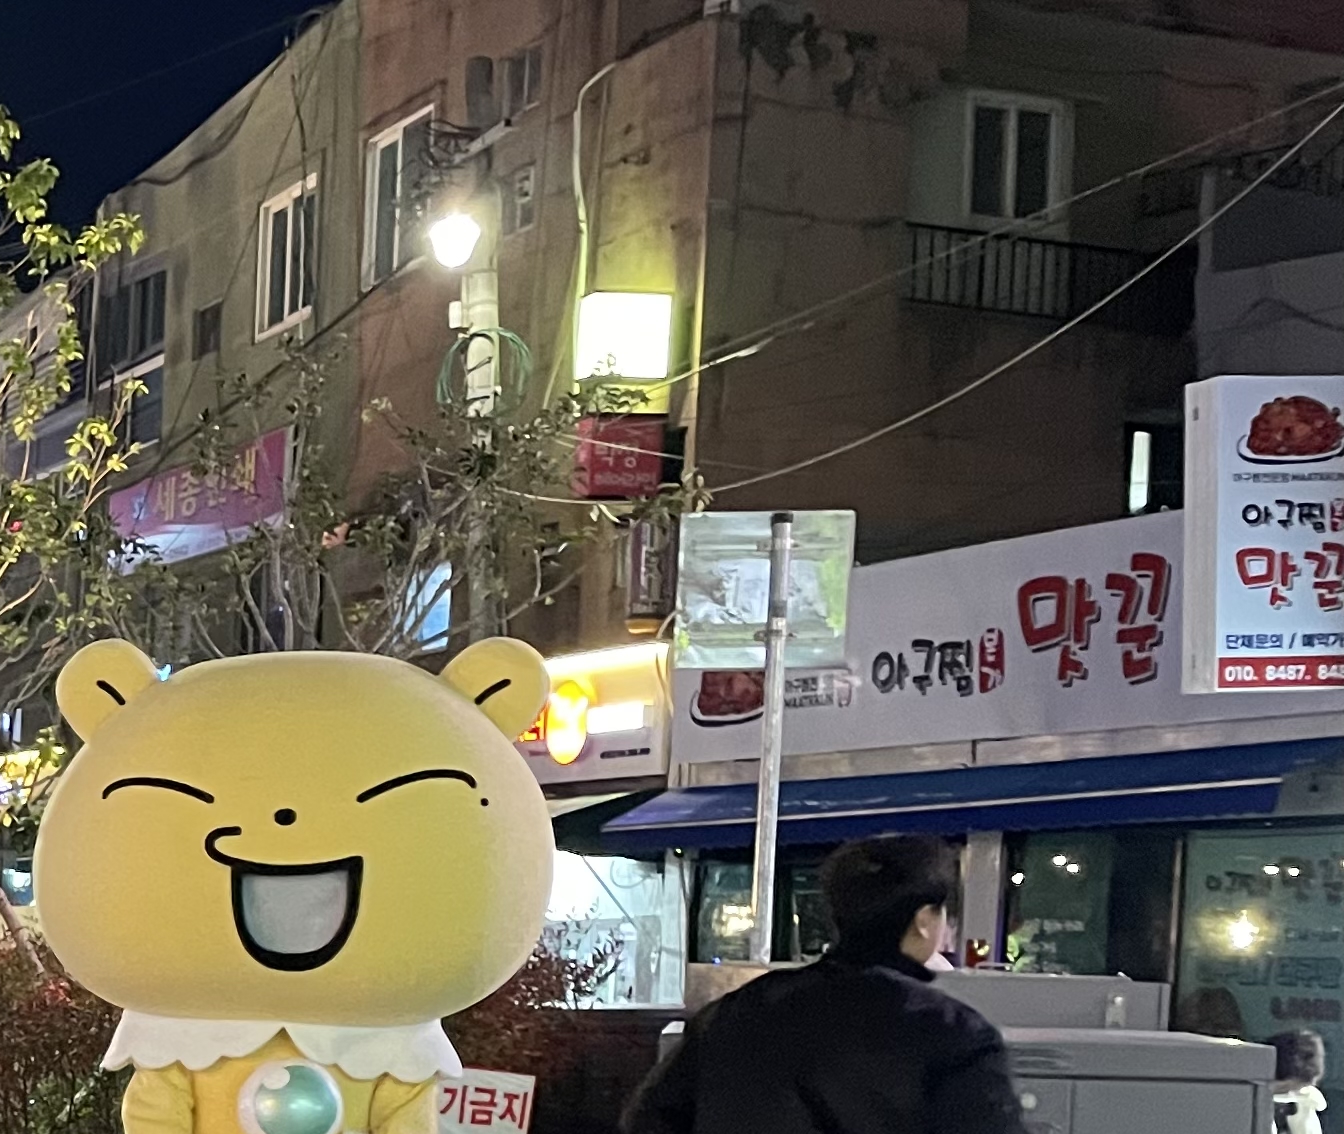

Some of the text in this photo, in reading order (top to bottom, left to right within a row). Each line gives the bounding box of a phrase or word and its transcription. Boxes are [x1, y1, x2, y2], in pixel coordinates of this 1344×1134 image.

[1241, 499, 1326, 533] 아구찜
[871, 638, 974, 698] 아구찜
[1018, 553, 1173, 687] 맛꾼
